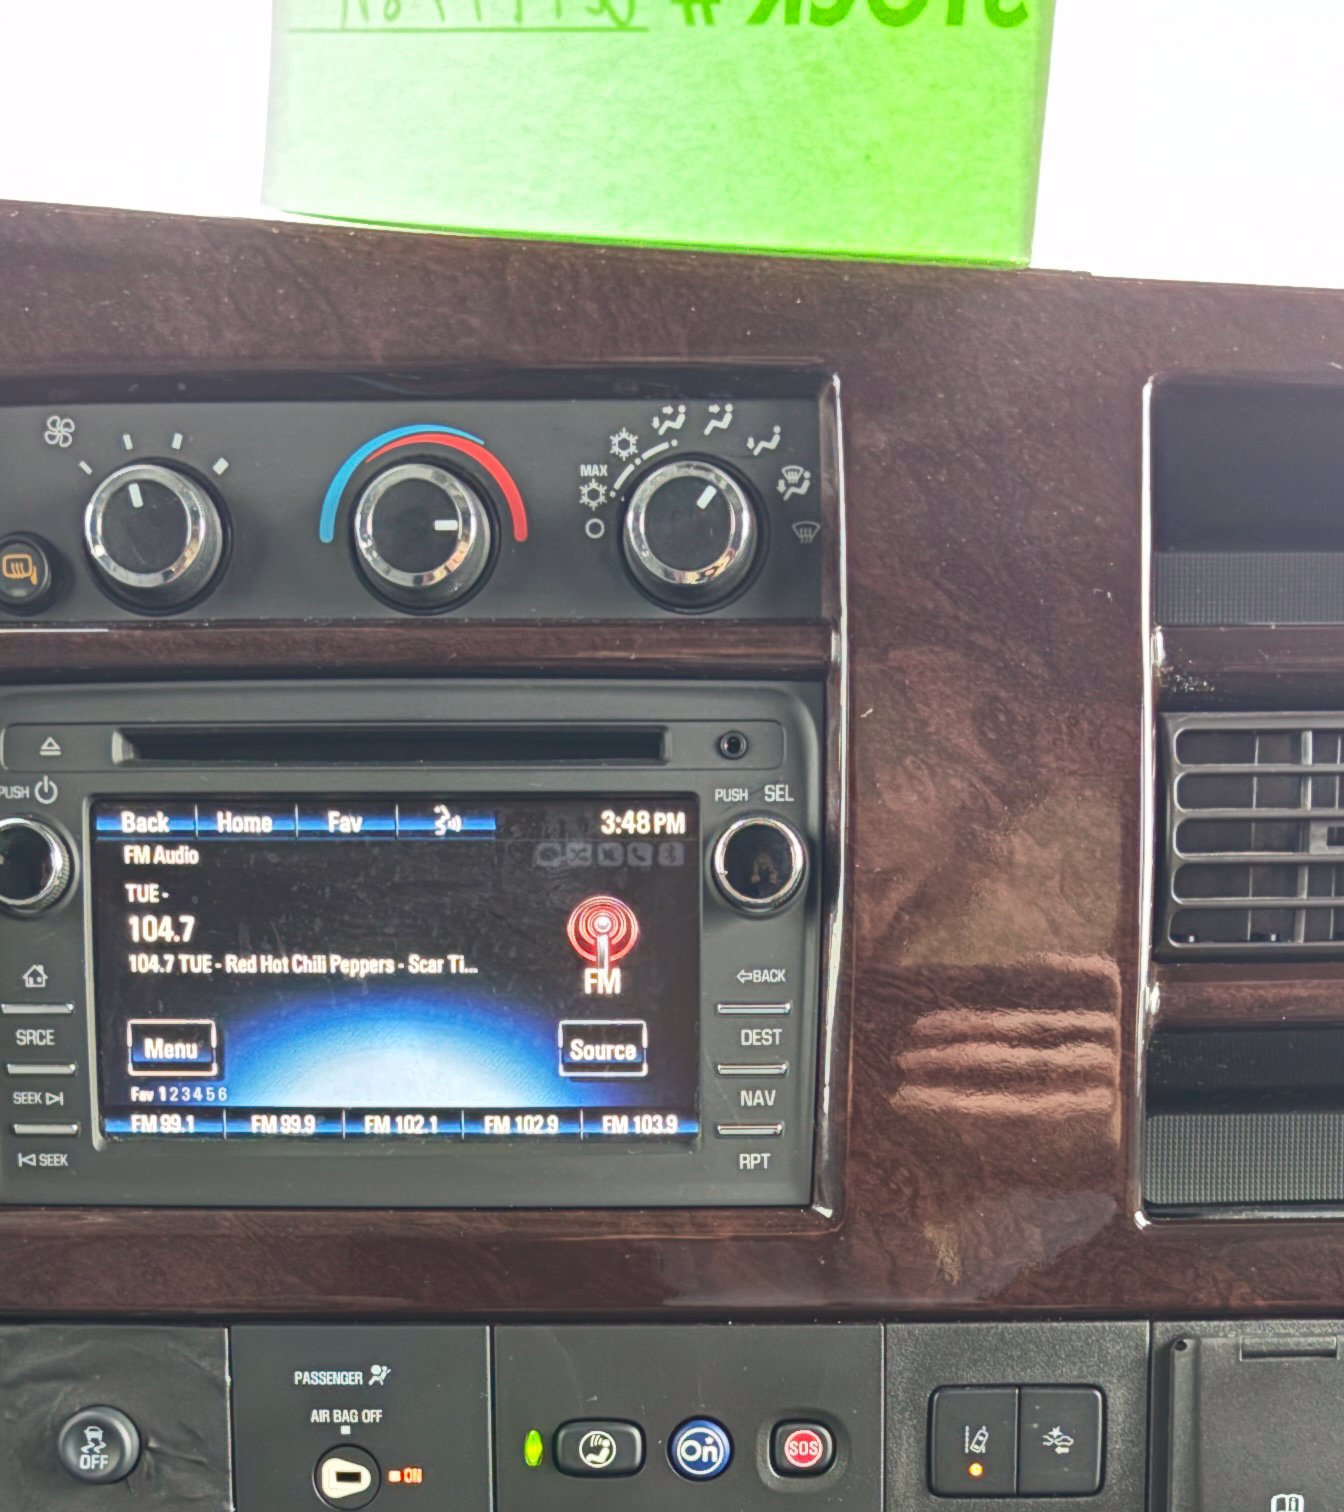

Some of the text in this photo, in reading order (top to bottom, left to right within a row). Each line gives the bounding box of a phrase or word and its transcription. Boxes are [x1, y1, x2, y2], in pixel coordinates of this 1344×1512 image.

[580, 464, 607, 477] MAX
[714, 784, 795, 802] PUSH SEL
[121, 811, 169, 834] Back
[217, 811, 273, 833] Home
[328, 811, 363, 833] Fav
[600, 809, 686, 835] 3:48 PM
[123, 845, 200, 865] FM Audio
[125, 883, 160, 904] TUE
[128, 915, 196, 943] 104.7
[128, 954, 174, 974] 104.7
[178, 954, 213, 974] TUE
[226, 954, 258, 974] Red
[261, 954, 290, 974] Hot
[292, 954, 327, 974] Chili
[330, 954, 395, 978] Peppers
[408, 954, 444, 974] Scar
[752, 969, 787, 983] BACK
[584, 967, 622, 994] FM
[15, 1029, 56, 1046] SRCE
[740, 1029, 783, 1046] DEST
[144, 1038, 199, 1060] Menu
[569, 1038, 638, 1061] Source
[12, 1091, 43, 1105] SEEK
[131, 1086, 154, 1102] Fav
[740, 1089, 777, 1107] NAV
[130, 1114, 195, 1134] FM 99.1
[250, 1114, 316, 1135] FM 99.9
[364, 1114, 438, 1134] FM 102.1
[483, 1114, 559, 1135] FM 102.9
[602, 1114, 679, 1135] FM 103.9
[39, 1153, 69, 1167] SEEK
[739, 1153, 771, 1170] RPT
[293, 1370, 364, 1386] PASSENGER
[310, 1408, 383, 1424] AIR BAG OFF
[680, 1436, 718, 1463] On
[788, 1439, 819, 1457] SOS
[78, 1454, 110, 1471] OFF
[403, 1467, 423, 1484] ON
